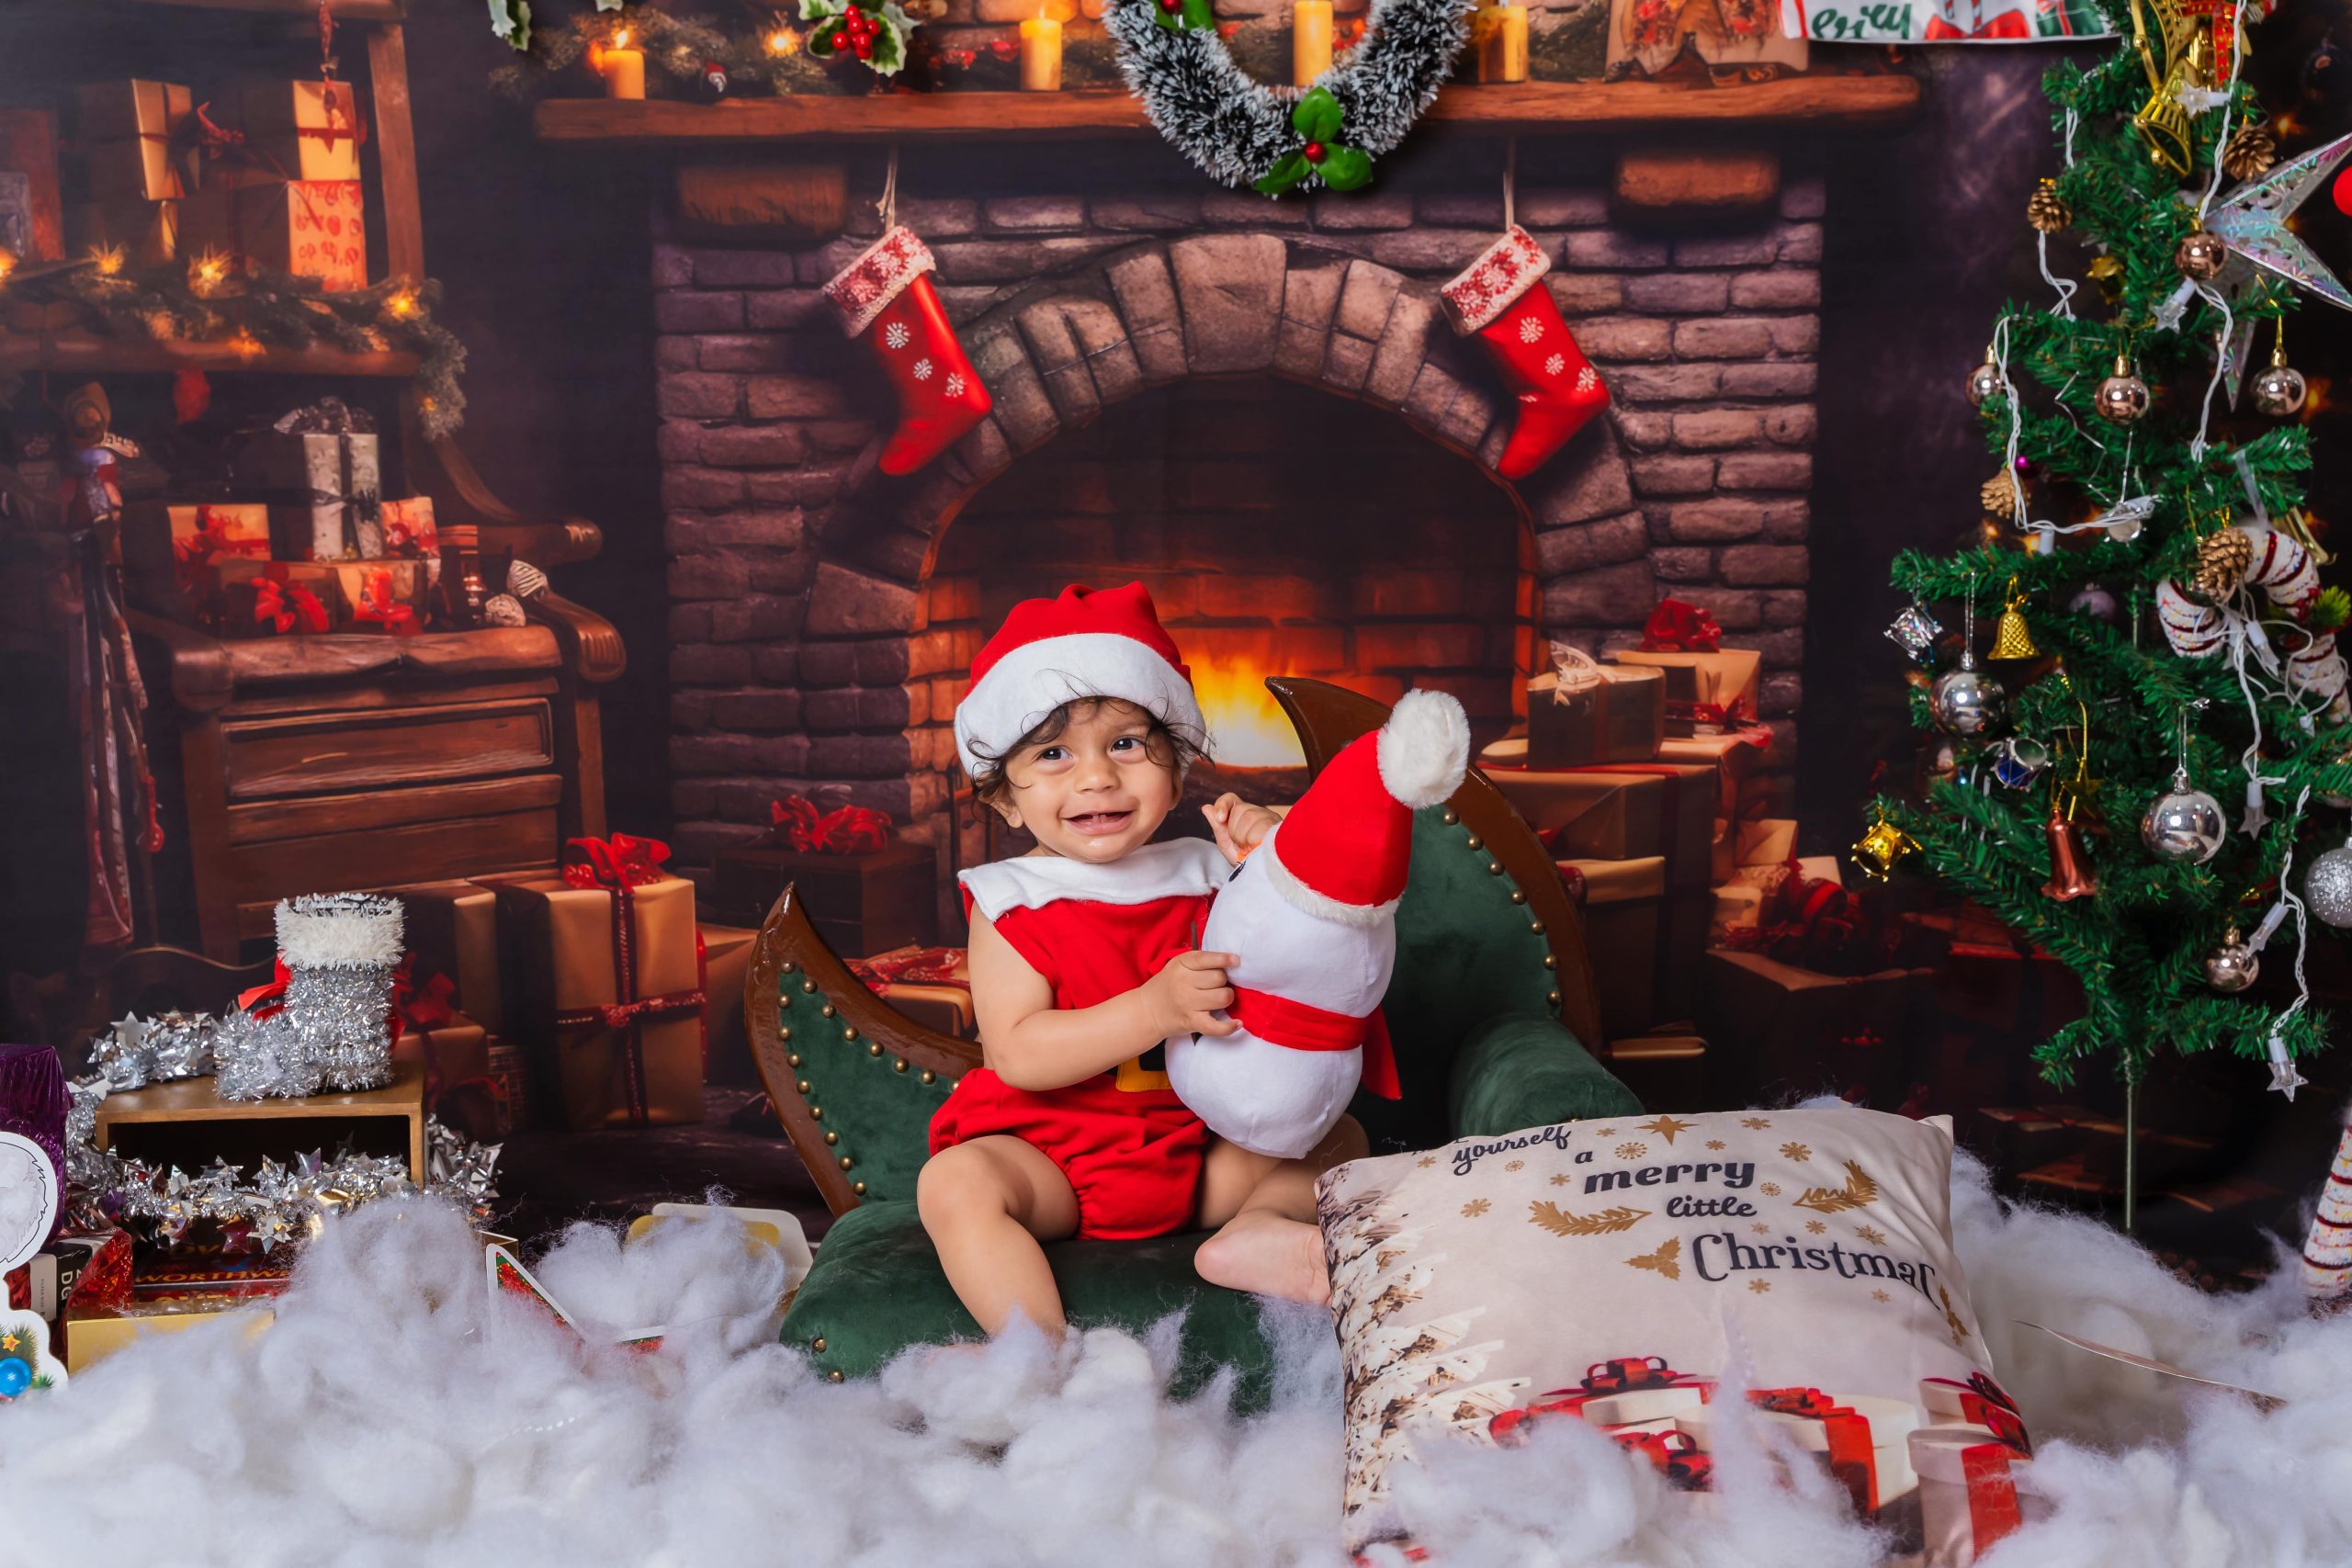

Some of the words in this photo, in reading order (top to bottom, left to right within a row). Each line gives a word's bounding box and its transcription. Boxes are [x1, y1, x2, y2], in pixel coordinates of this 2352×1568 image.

[1451, 1125, 1571, 1176] yourself
[1574, 1150, 1594, 1165] a
[1583, 1162, 1756, 1194] merry
[1666, 1196, 1758, 1218] little
